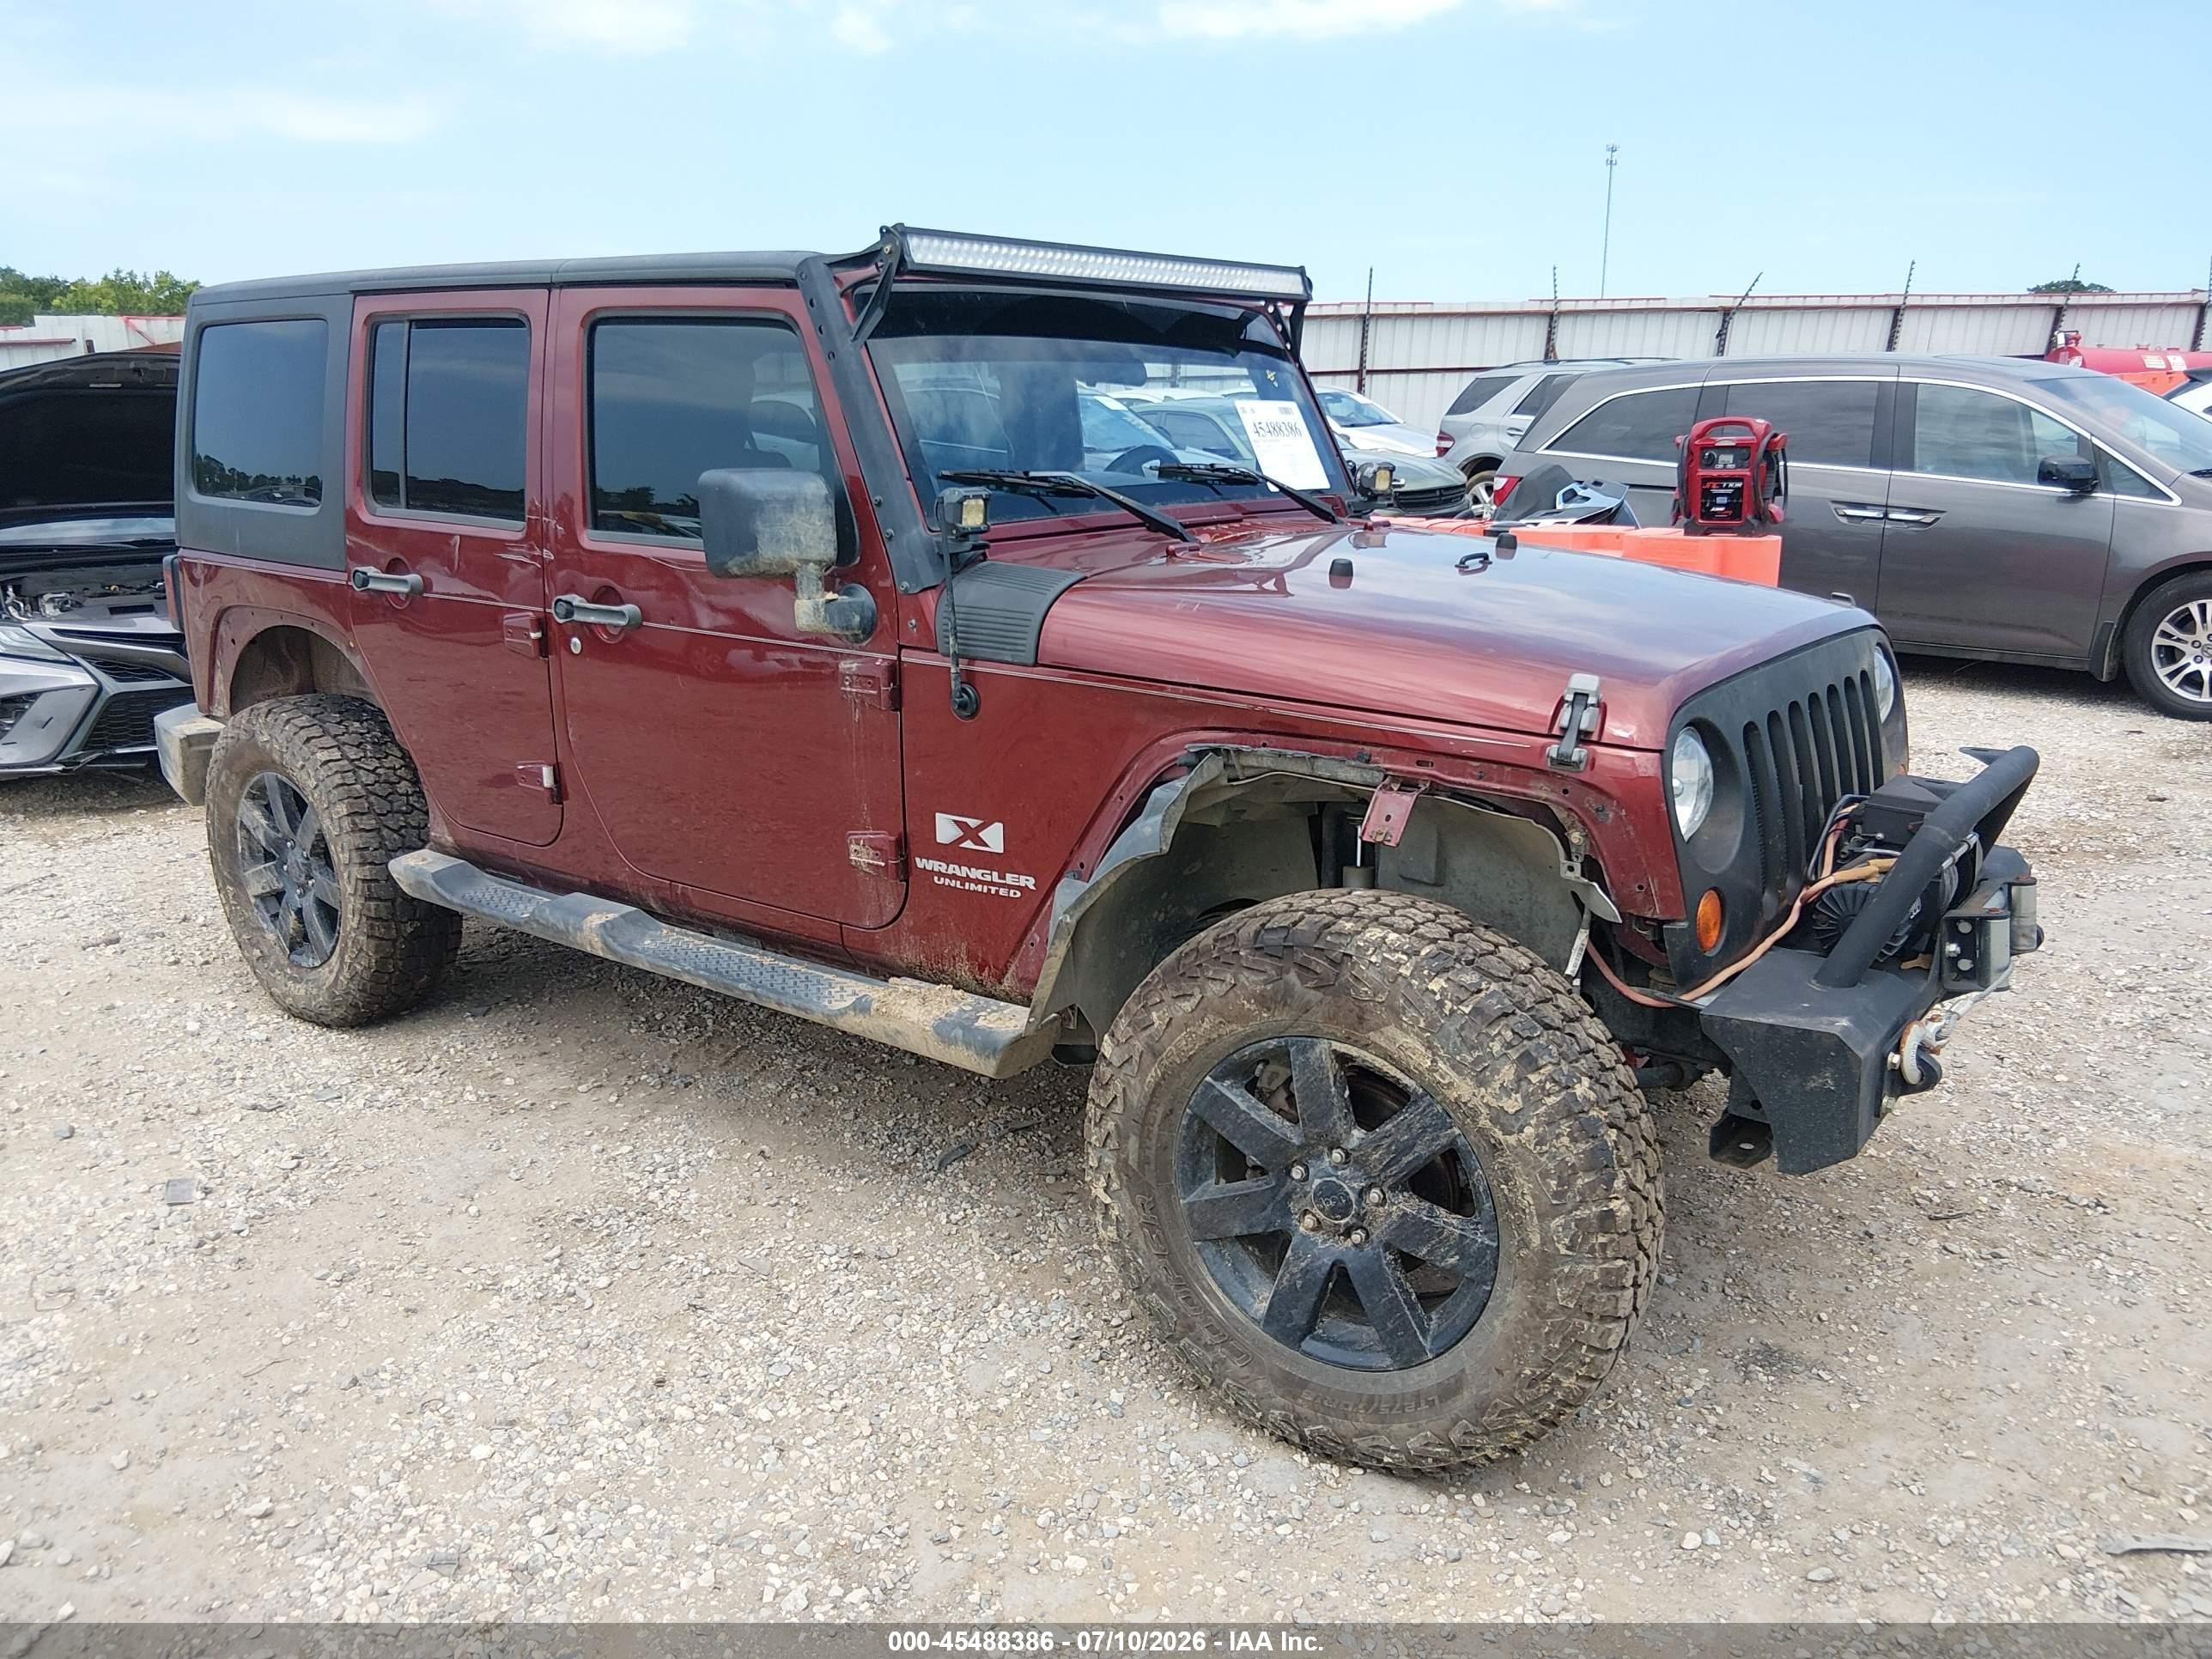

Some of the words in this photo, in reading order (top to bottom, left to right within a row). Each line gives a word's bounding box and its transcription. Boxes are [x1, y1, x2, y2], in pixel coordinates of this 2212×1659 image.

[1253, 422, 1303, 438] 45488386
[915, 856, 1037, 890] WRANGLER
[933, 875, 1022, 898] UNLIMITED
